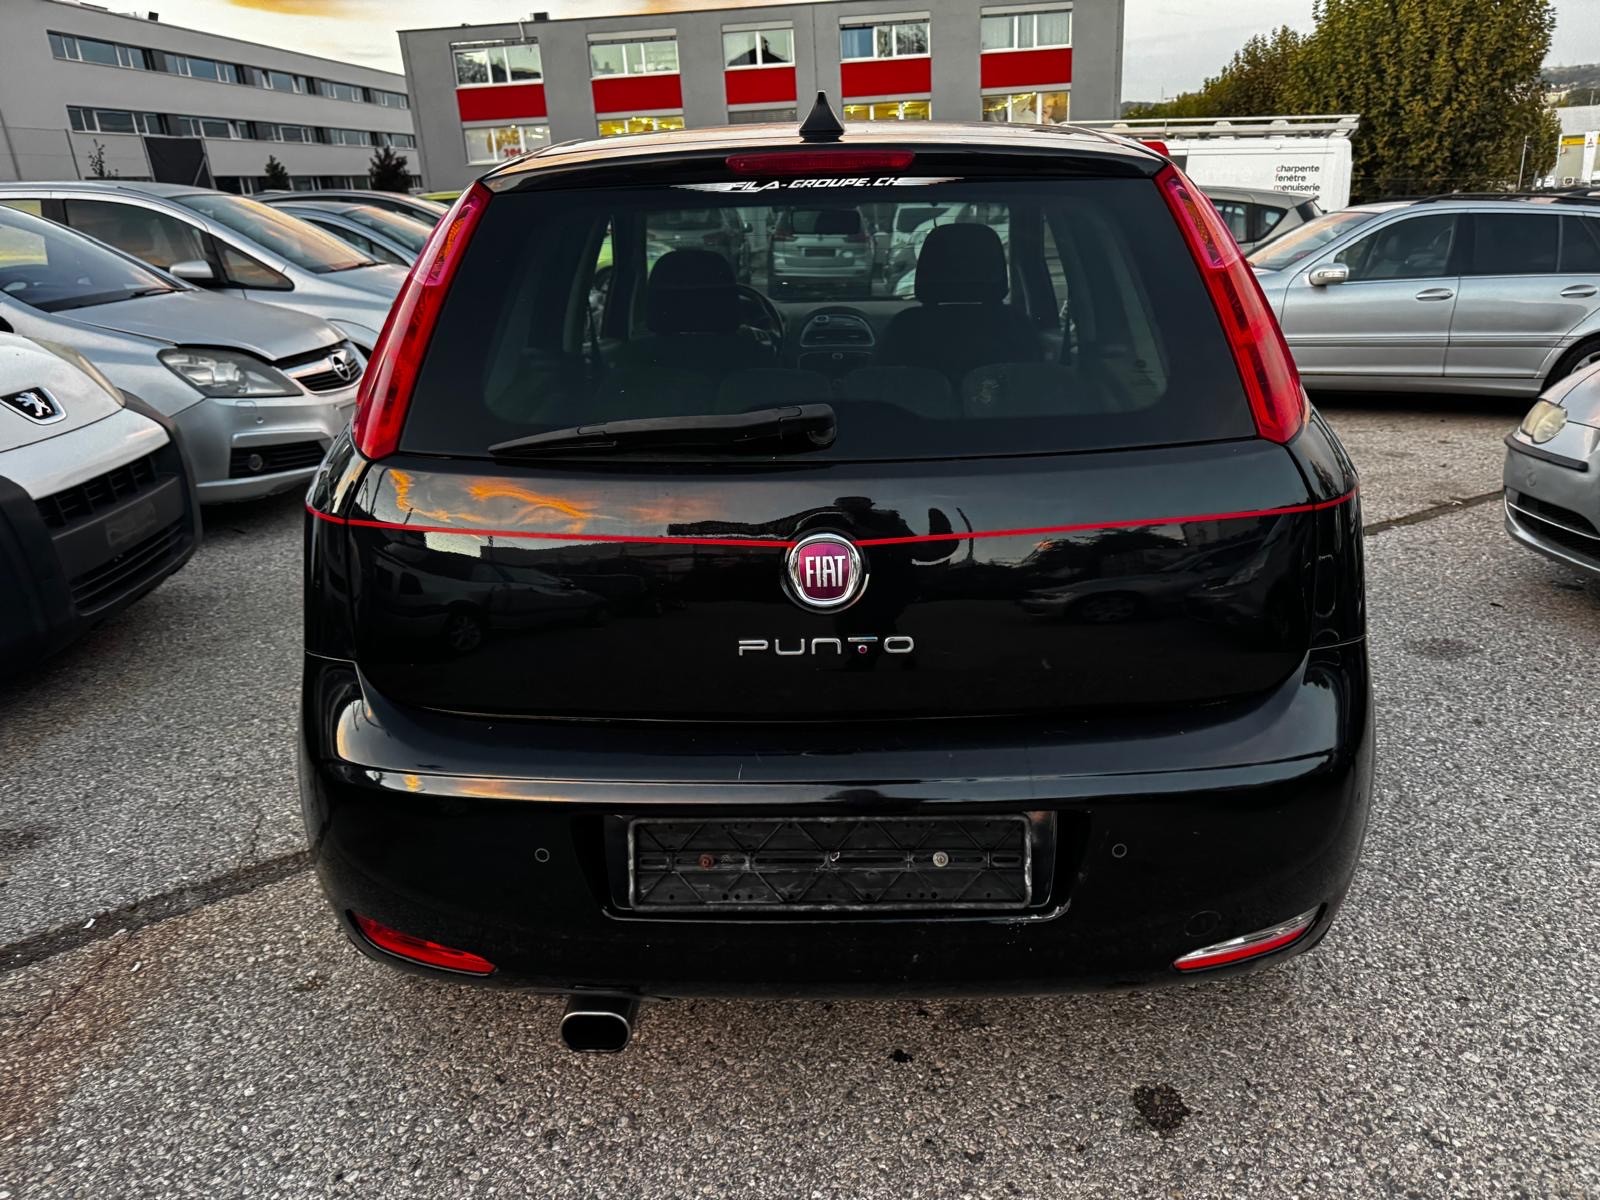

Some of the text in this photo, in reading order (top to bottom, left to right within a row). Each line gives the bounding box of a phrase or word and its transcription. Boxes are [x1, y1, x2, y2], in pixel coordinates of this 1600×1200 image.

[1276, 165, 1320, 173] charpente
[729, 177, 904, 192] FILA-GROUPE.CH
[1273, 183, 1320, 191] menuiserie
[805, 555, 846, 588] FIAT
[738, 636, 915, 656] PUNTO
